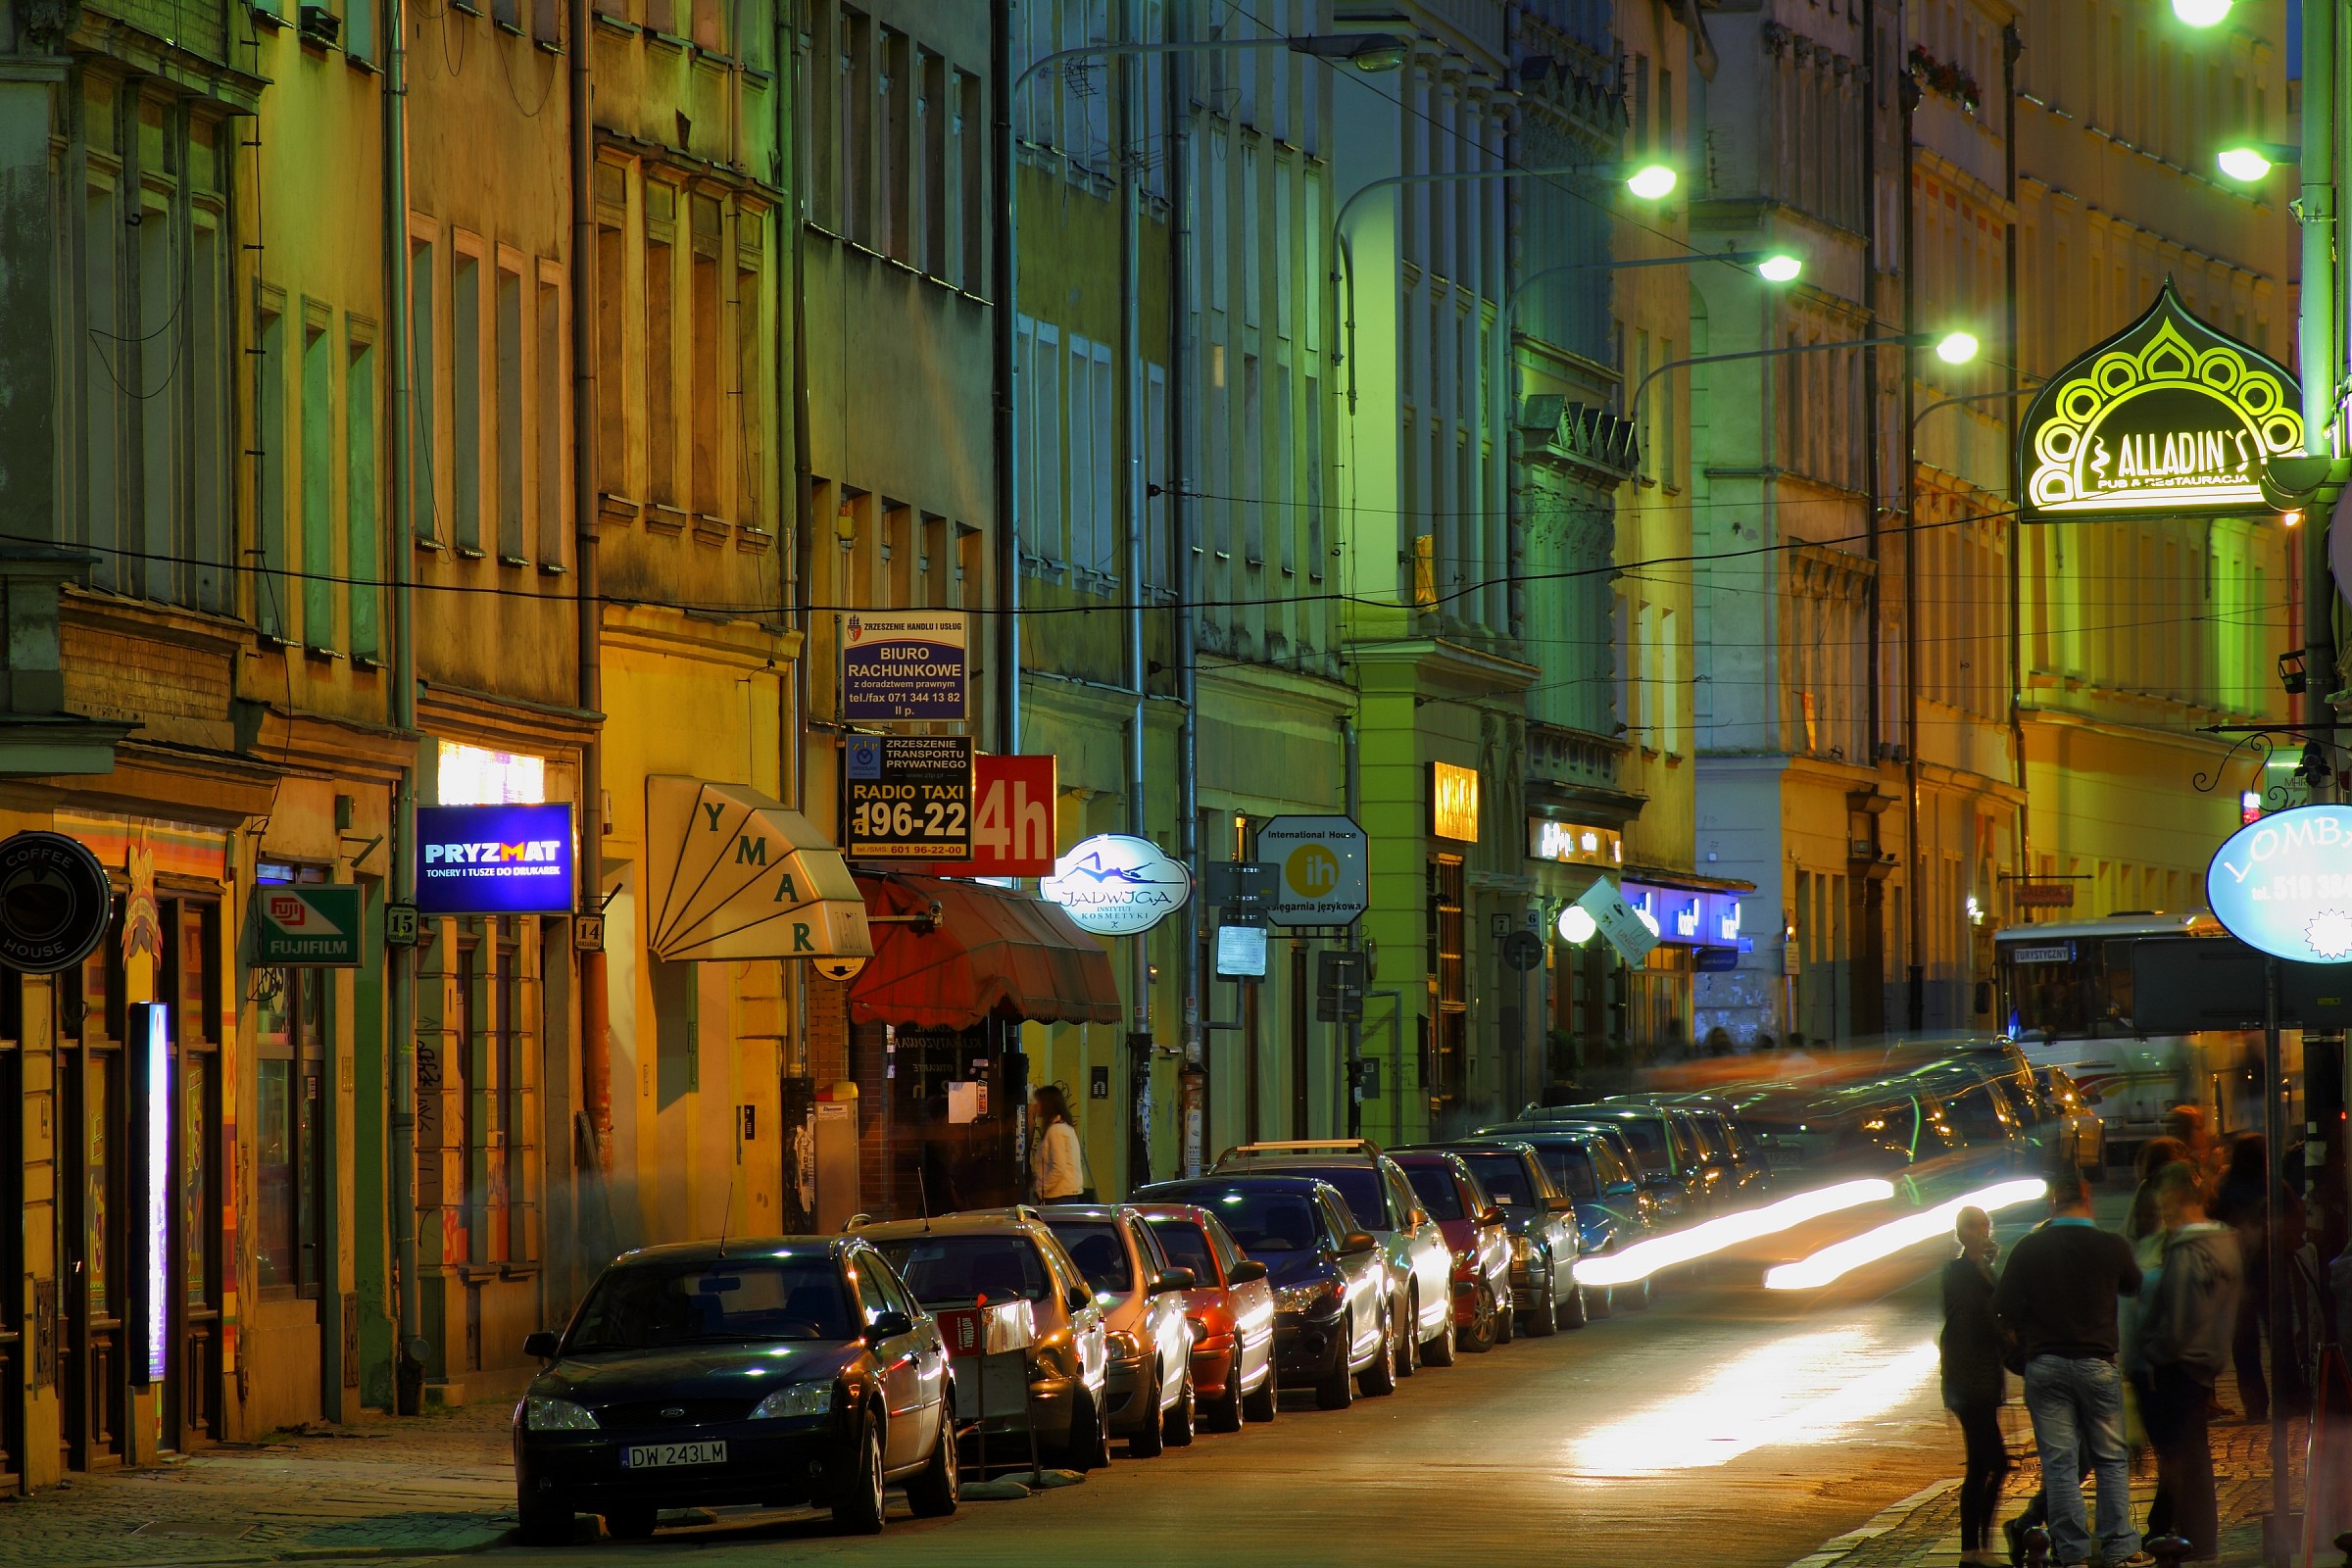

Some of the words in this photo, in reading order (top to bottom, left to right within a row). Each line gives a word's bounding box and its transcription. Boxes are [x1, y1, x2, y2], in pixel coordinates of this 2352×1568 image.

[2097, 473, 2129, 489] PUB
[2144, 469, 2250, 487] RESTAURACJA
[863, 622, 906, 631] ZRZESZENIE
[906, 622, 934, 631] HANDLU
[940, 622, 962, 631] USŁUG
[880, 647, 930, 661] BIURO
[848, 663, 962, 677] RACHUNKOWE
[860, 679, 914, 689] doradztwem
[915, 681, 956, 690] prawnym
[849, 692, 885, 703] tel./fax
[888, 692, 906, 703] 071
[909, 692, 930, 703] 344
[932, 692, 945, 703] 13
[947, 692, 961, 703] 82
[905, 706, 915, 717] p.
[886, 740, 957, 749] ZRZESZENIE
[886, 750, 965, 759] TRANSPORTU
[886, 760, 967, 769] PRYWATNEGO
[854, 784, 916, 801] RADIO
[921, 784, 964, 801] TAXI
[855, 802, 966, 837] 196-22
[1267, 830, 1326, 839] International
[1329, 830, 1356, 839] House
[425, 840, 562, 863] PRYZMAT
[891, 846, 911, 855] 601
[913, 846, 962, 855] 96-22-00
[5, 848, 74, 869] COFFEE
[426, 867, 461, 878] TONERY
[468, 867, 495, 877] TUSZE
[496, 866, 513, 876] DO
[513, 865, 561, 876] DRUKAREK
[1305, 855, 1337, 886] ih
[2273, 874, 2313, 901] 519
[1317, 901, 1361, 913] językowa
[1081, 911, 1150, 920] KOSMETYKI
[1528, 913, 1537, 924] 6
[392, 914, 413, 933] 15
[1498, 919, 1505, 931] 7
[580, 923, 599, 940] 14
[3, 938, 66, 958] HOUSE
[270, 940, 348, 955] FUJIFILM
[2016, 948, 2066, 960] TURYSTYCZNY
[961, 1317, 975, 1348] ROTOMAT
[632, 1447, 659, 1467] DW
[666, 1443, 724, 1464] 243LM
